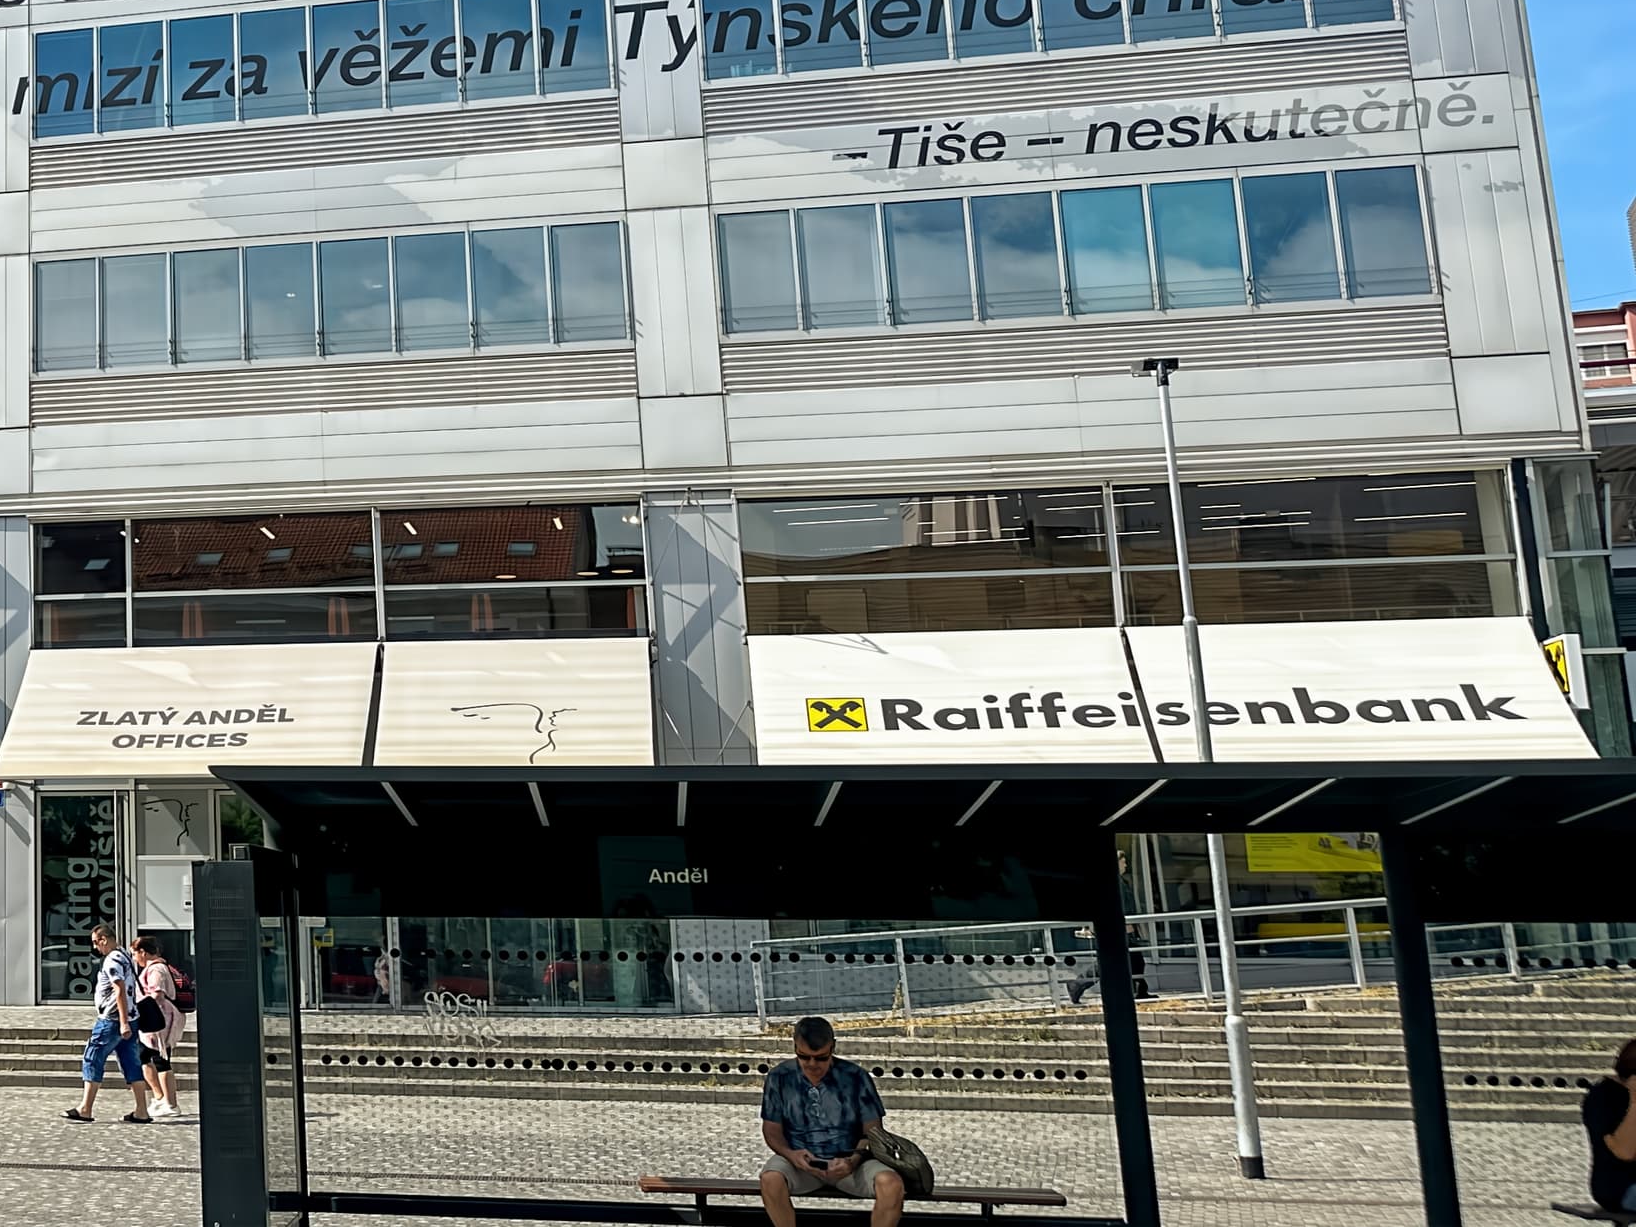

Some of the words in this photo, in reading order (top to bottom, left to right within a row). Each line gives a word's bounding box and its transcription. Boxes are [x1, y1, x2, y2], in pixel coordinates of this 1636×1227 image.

[182, 52, 269, 102] za
[297, 9, 583, 90] věžemi
[876, 120, 1007, 170] Tiše
[1083, 81, 1496, 155] neskutečně.
[76, 706, 180, 726] ZLATÝ
[183, 703, 295, 726] ANDĚL
[880, 683, 1529, 732] Raiffeisenbank
[112, 732, 249, 749] OFFICES
[648, 867, 708, 884] Anděl
[67, 857, 99, 999] parking
